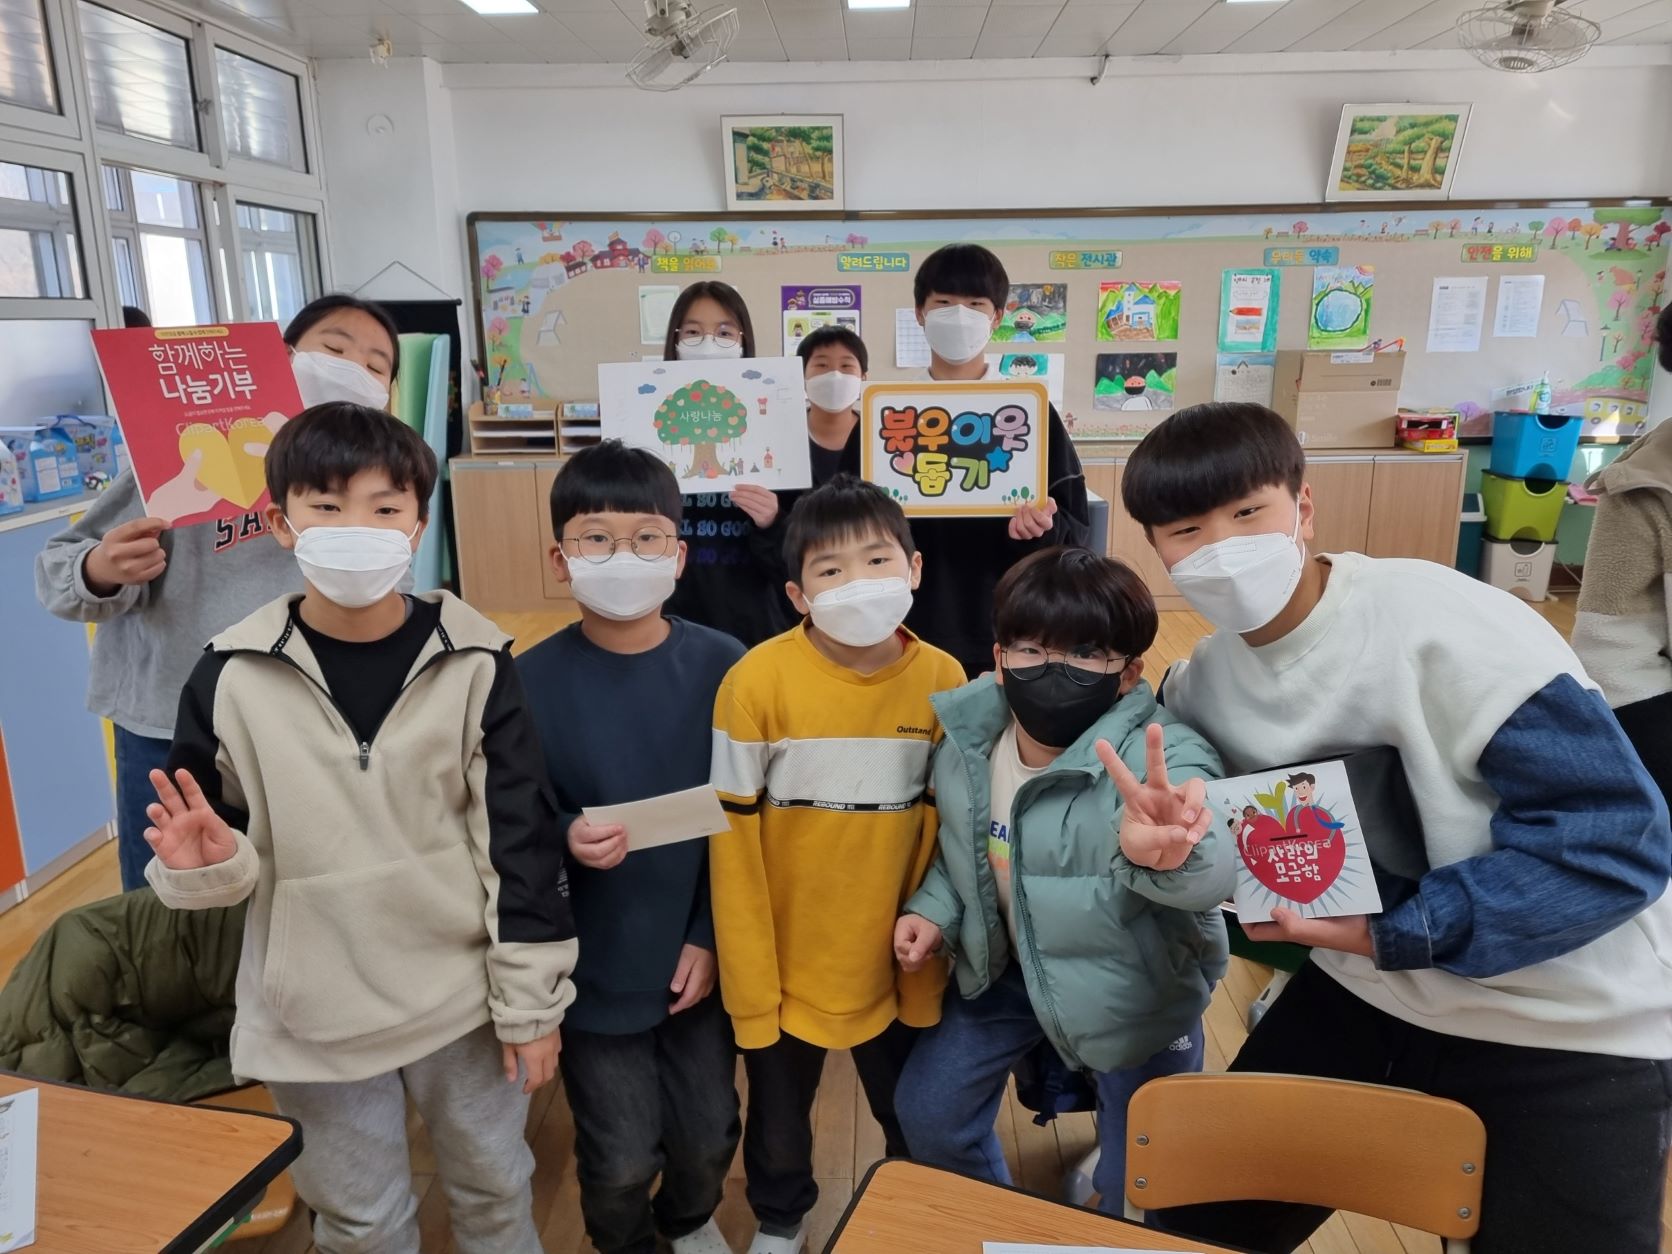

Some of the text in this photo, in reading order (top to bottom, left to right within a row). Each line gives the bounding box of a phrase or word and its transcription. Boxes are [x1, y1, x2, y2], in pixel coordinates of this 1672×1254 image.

[1055, 252, 1117, 268] 작은 전시관
[1309, 249, 1332, 263] 약속
[1507, 247, 1533, 259] 위해
[656, 257, 679, 272] 책을
[840, 254, 907, 270] 알려드립니다
[148, 341, 248, 375] 함께하는
[159, 370, 257, 405] 나눔기부
[680, 410, 723, 423] 사랑나눔
[912, 451, 991, 497] 돕기
[214, 511, 272, 552] SA
[812, 800, 846, 810] REBOUND
[1267, 842, 1319, 865] 사랑의
[1275, 863, 1322, 884] 모금함
